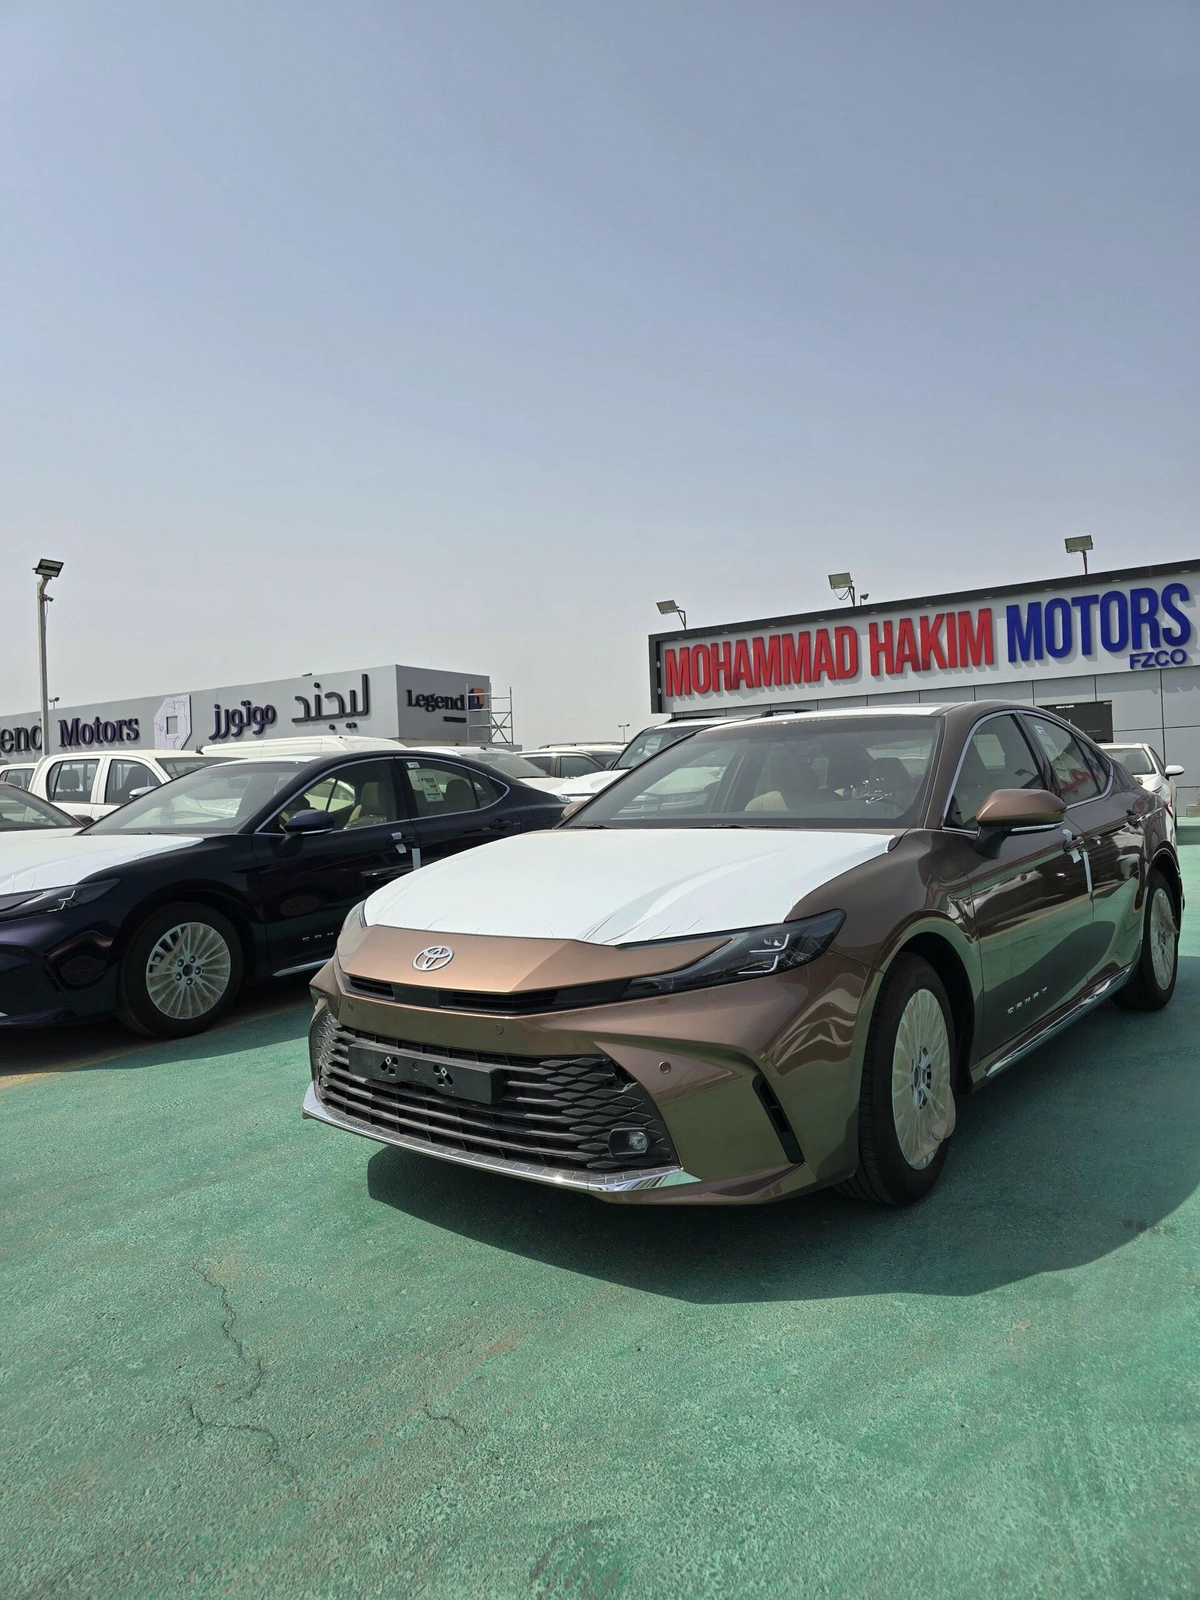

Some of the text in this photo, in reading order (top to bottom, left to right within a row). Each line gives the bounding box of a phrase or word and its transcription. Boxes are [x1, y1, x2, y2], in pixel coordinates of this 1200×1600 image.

[664, 582, 1192, 697] MOHAMMAD HAKIM MOTORS
[1129, 648, 1188, 670] FZCO
[208, 673, 370, 740] ليجند موتورز
[406, 689, 467, 712] Legend
[57, 716, 141, 747] Motors
[1006, 986, 1048, 1014] CAMRY
